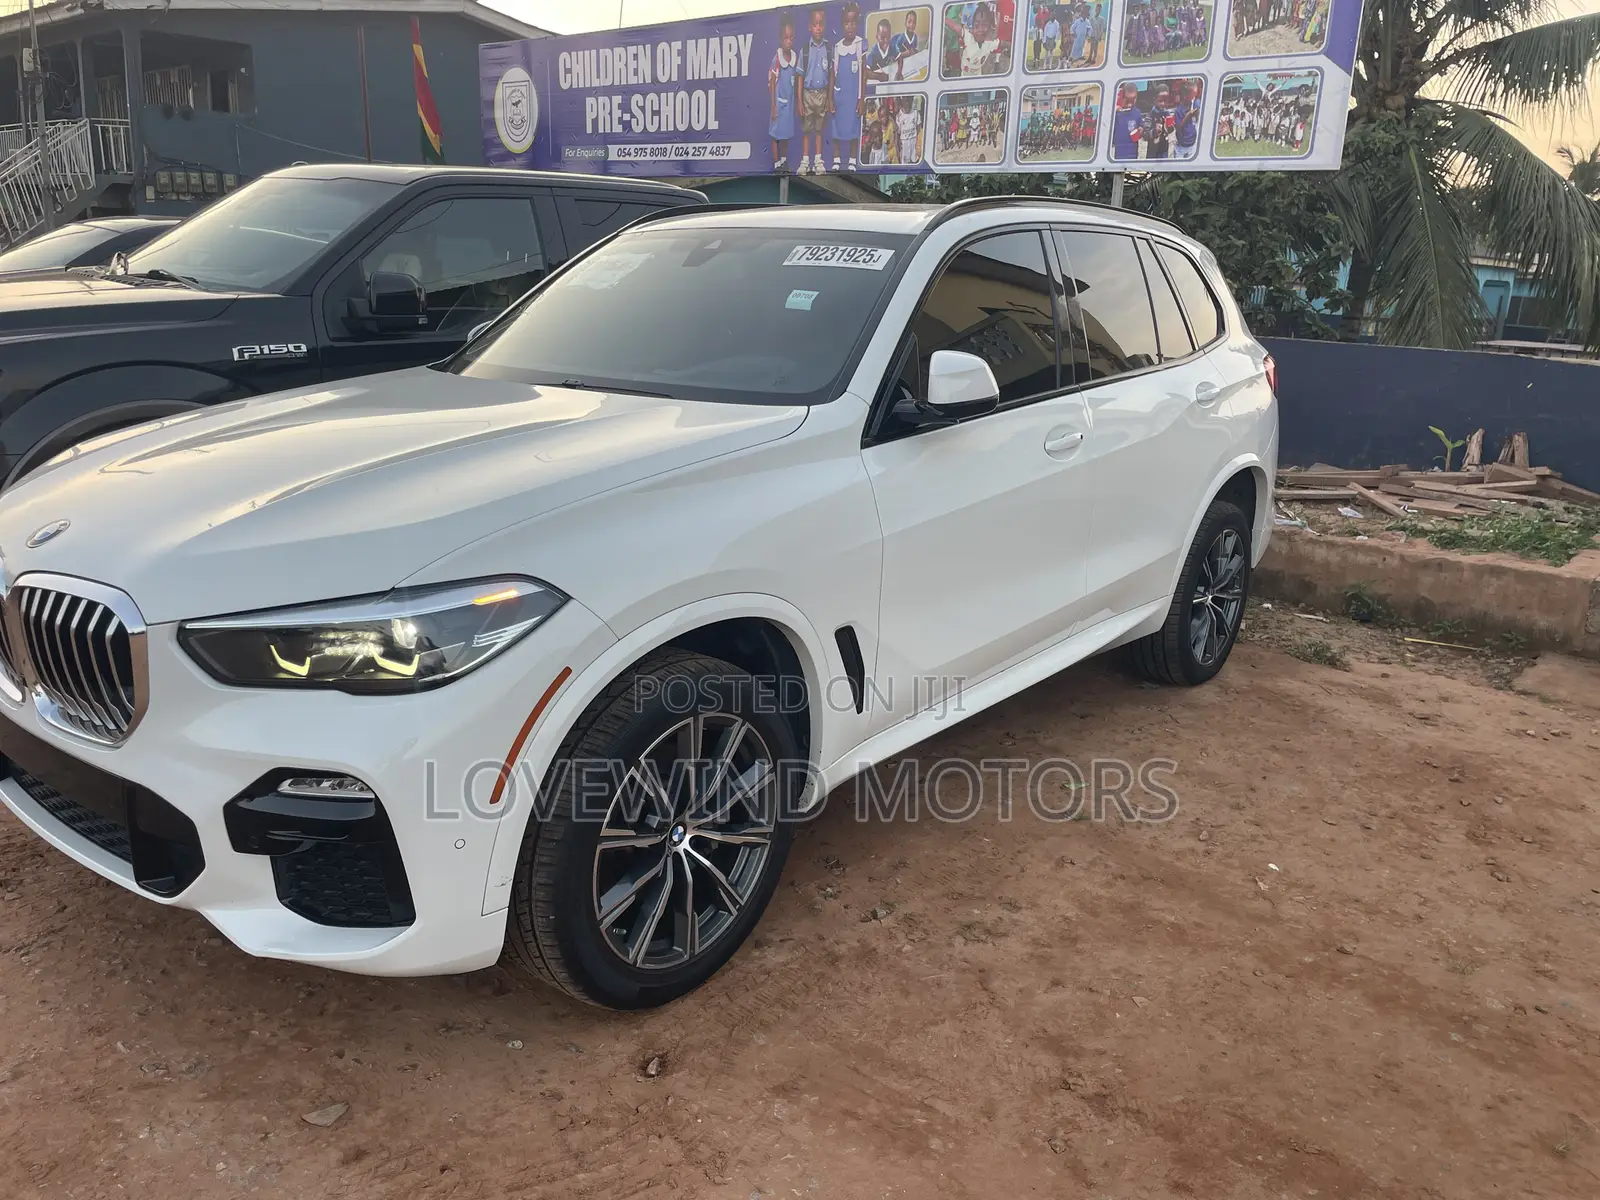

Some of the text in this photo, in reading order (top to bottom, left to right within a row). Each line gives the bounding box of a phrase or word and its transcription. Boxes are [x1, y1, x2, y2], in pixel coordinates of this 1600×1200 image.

[558, 33, 754, 90] CHILDREN OF MARY
[585, 89, 719, 134] PRE-SCHOOL
[564, 148, 576, 157] For
[616, 147, 632, 158] 054
[633, 147, 648, 158] 975
[649, 146, 667, 158] 8018
[674, 146, 690, 157] 024
[691, 146, 707, 157] 257
[708, 145, 732, 157] 4837
